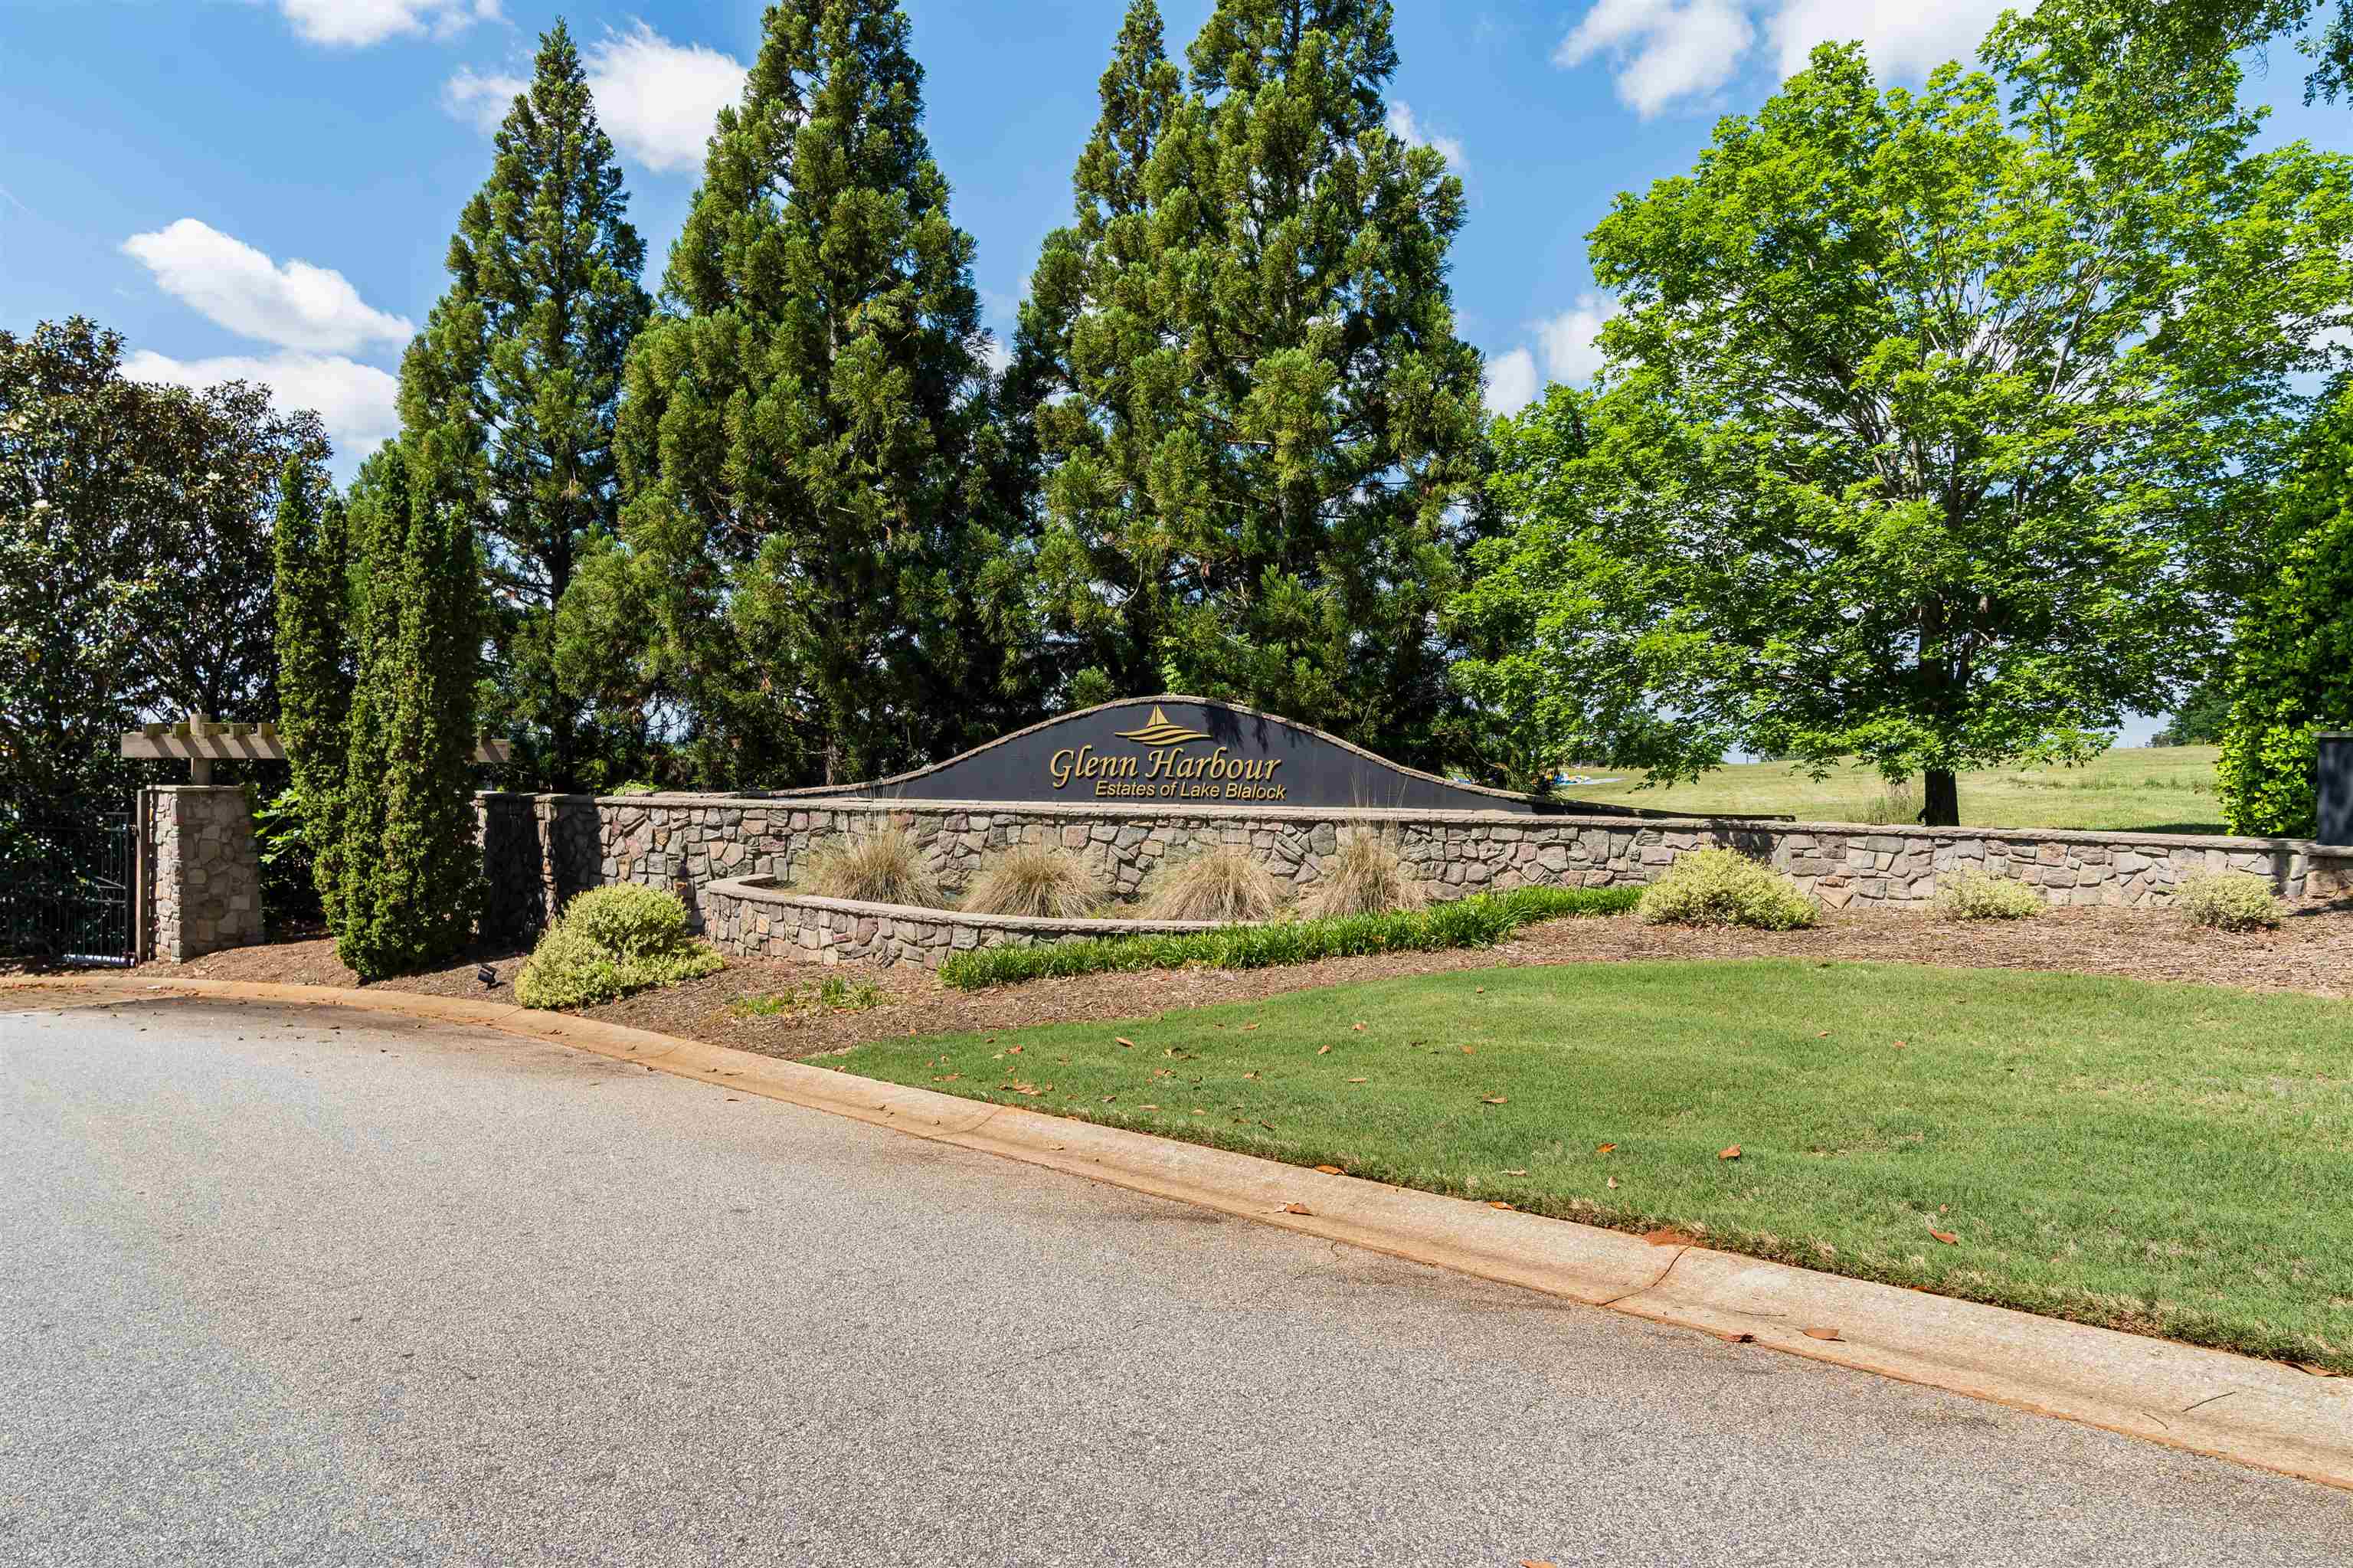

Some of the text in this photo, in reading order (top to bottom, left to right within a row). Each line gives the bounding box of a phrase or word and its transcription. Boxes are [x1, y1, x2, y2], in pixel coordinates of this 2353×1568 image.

[1049, 745, 1282, 788] Glenn Harbour
[1095, 781, 1288, 800] Estates of Lake Blalock
